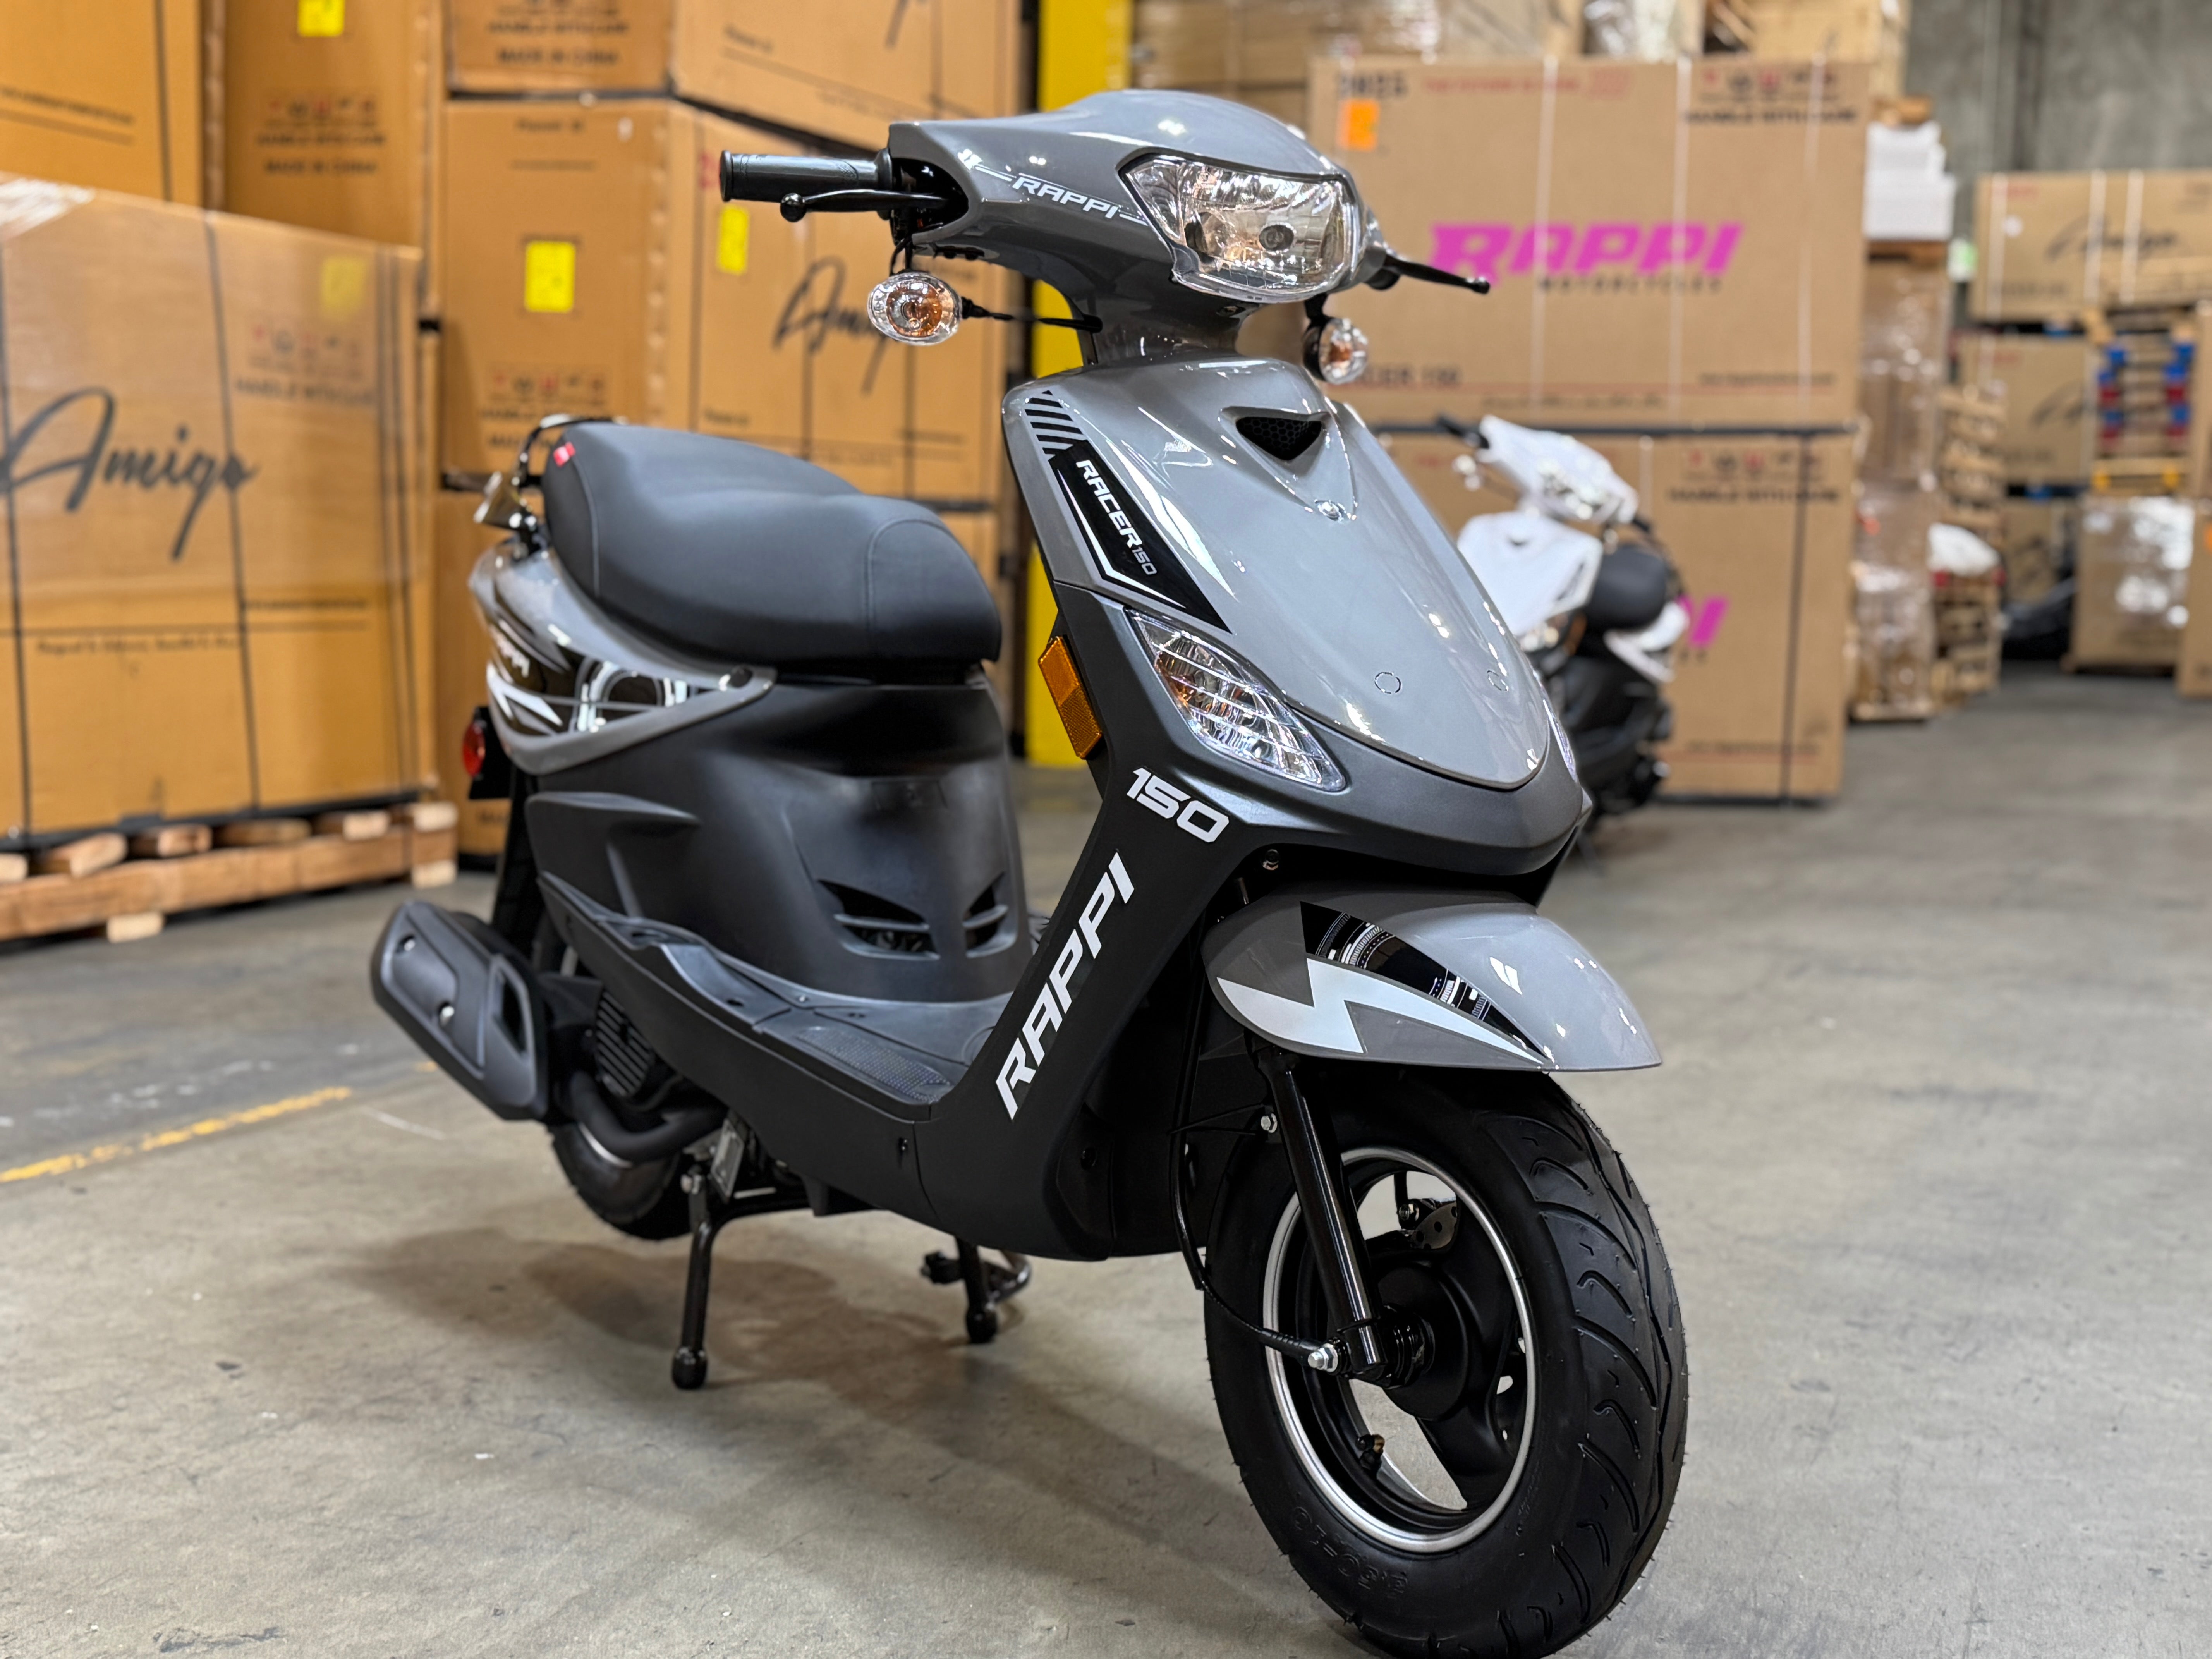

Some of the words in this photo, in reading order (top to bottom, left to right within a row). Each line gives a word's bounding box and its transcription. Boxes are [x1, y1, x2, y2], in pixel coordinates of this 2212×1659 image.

[1012, 177, 1118, 218] RAPPI
[1429, 221, 1743, 287] RAPPI
[0, 386, 259, 562] Amigo
[1075, 459, 1143, 548] RACER
[1127, 768, 1230, 843] 150
[996, 852, 1135, 1120] RAPPI
